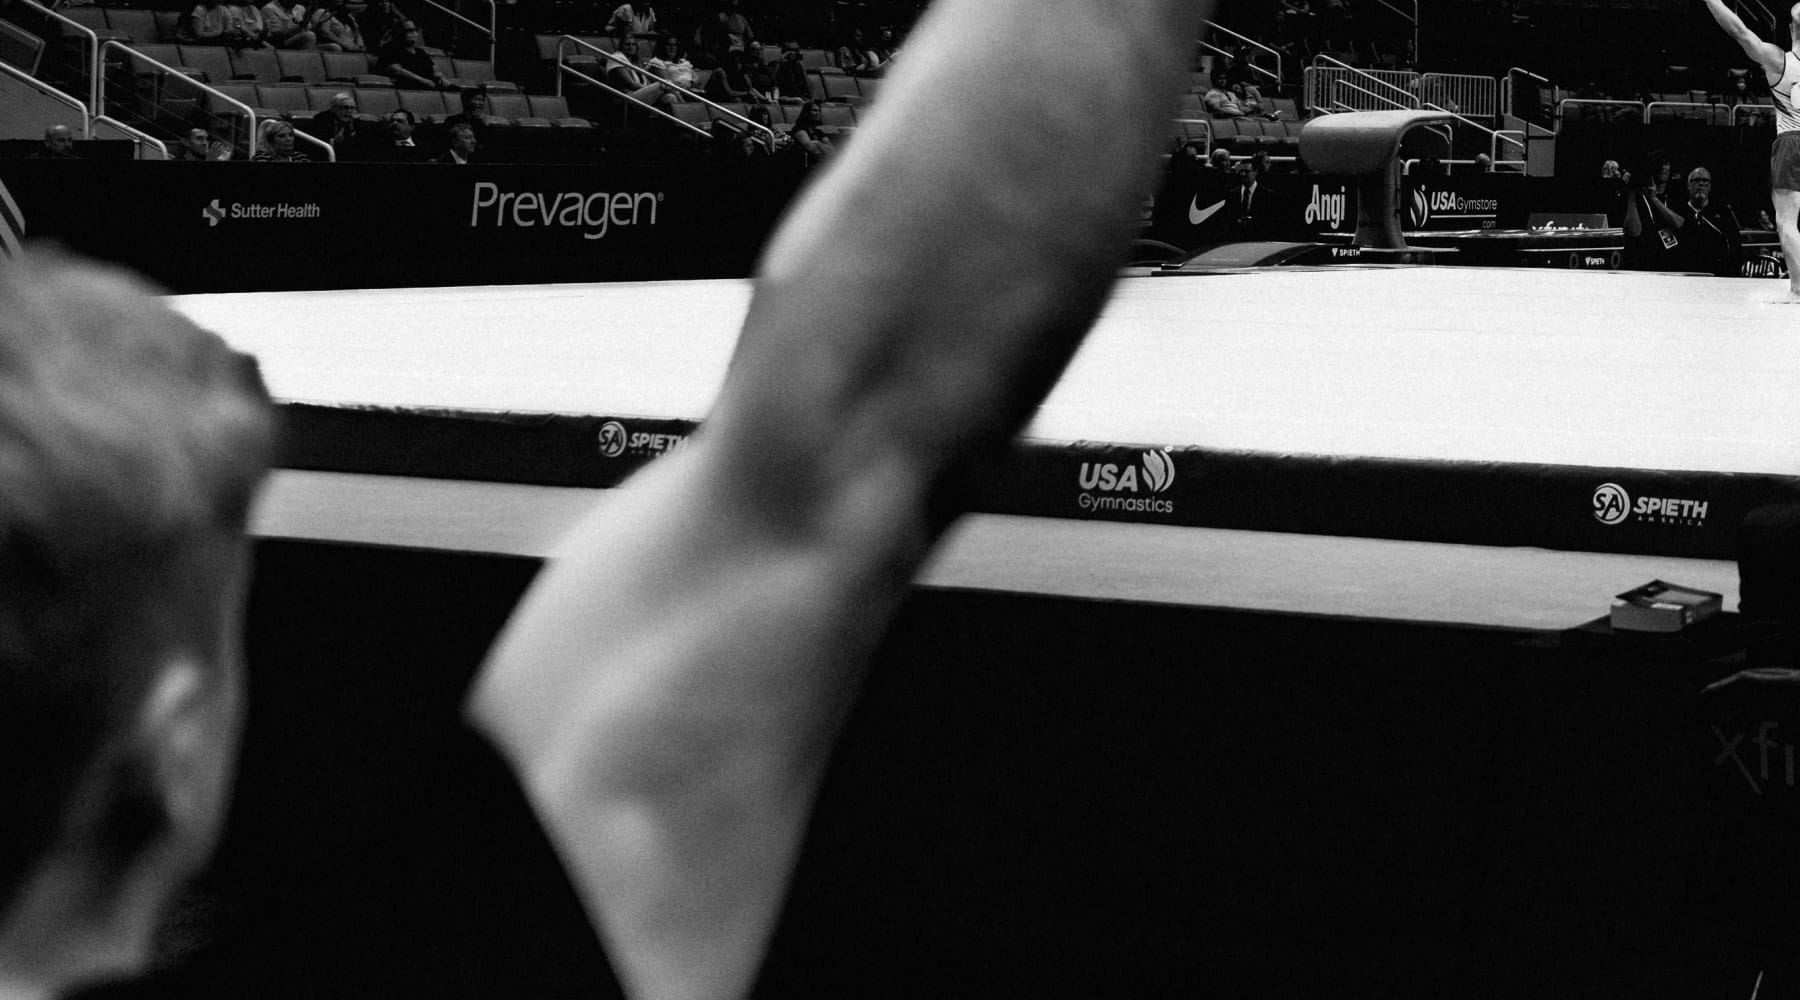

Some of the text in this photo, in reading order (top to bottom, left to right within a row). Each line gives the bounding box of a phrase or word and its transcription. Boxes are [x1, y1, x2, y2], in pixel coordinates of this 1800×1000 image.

[230, 202, 321, 218] Sutter Health
[1304, 184, 1346, 230] Angi
[1078, 462, 1138, 493] USA
[1078, 492, 1174, 514] Gymnastics
[1632, 496, 1709, 520] SPIETH
